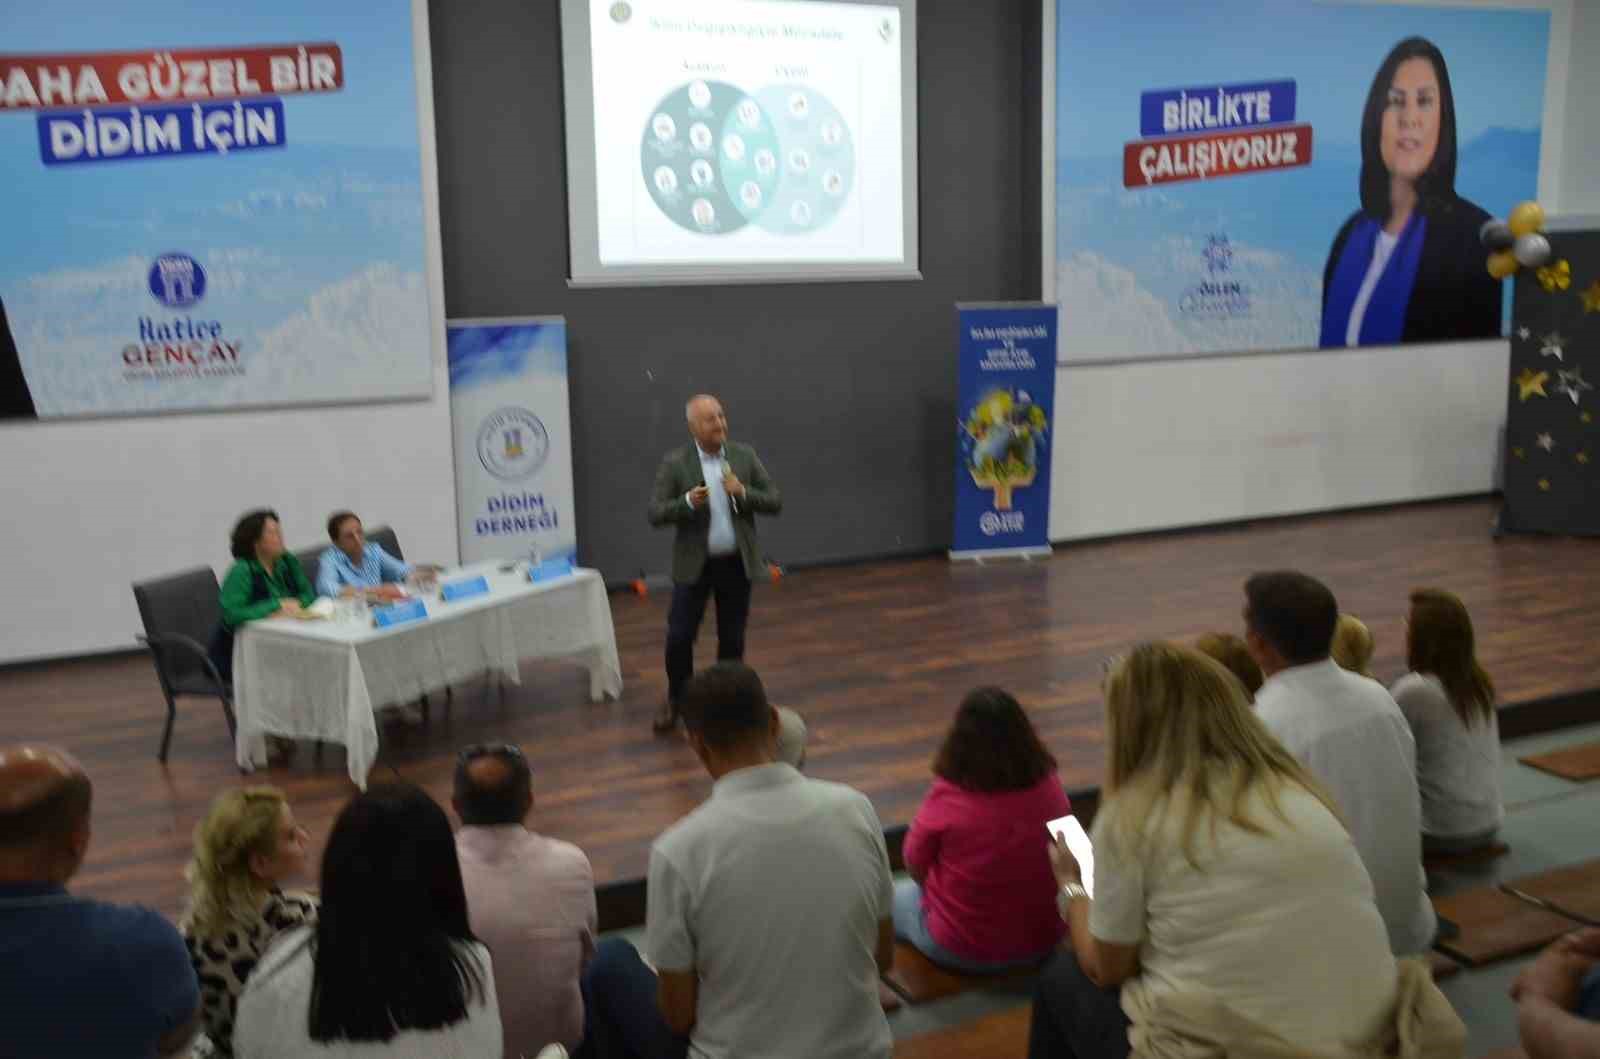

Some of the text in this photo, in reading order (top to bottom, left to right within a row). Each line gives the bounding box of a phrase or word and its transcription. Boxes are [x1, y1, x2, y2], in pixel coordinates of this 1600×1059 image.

[0, 45, 337, 108] AHA GÜZEL BİR
[50, 100, 276, 160] DİDİM İÇİN
[1163, 88, 1271, 133] BİRLİKTE
[1139, 132, 1298, 186] ÇALIŞIYORUZ
[122, 337, 241, 368] GENÇAY
[475, 505, 558, 535] DERNEĞİ
[487, 491, 544, 513] DİDİM
